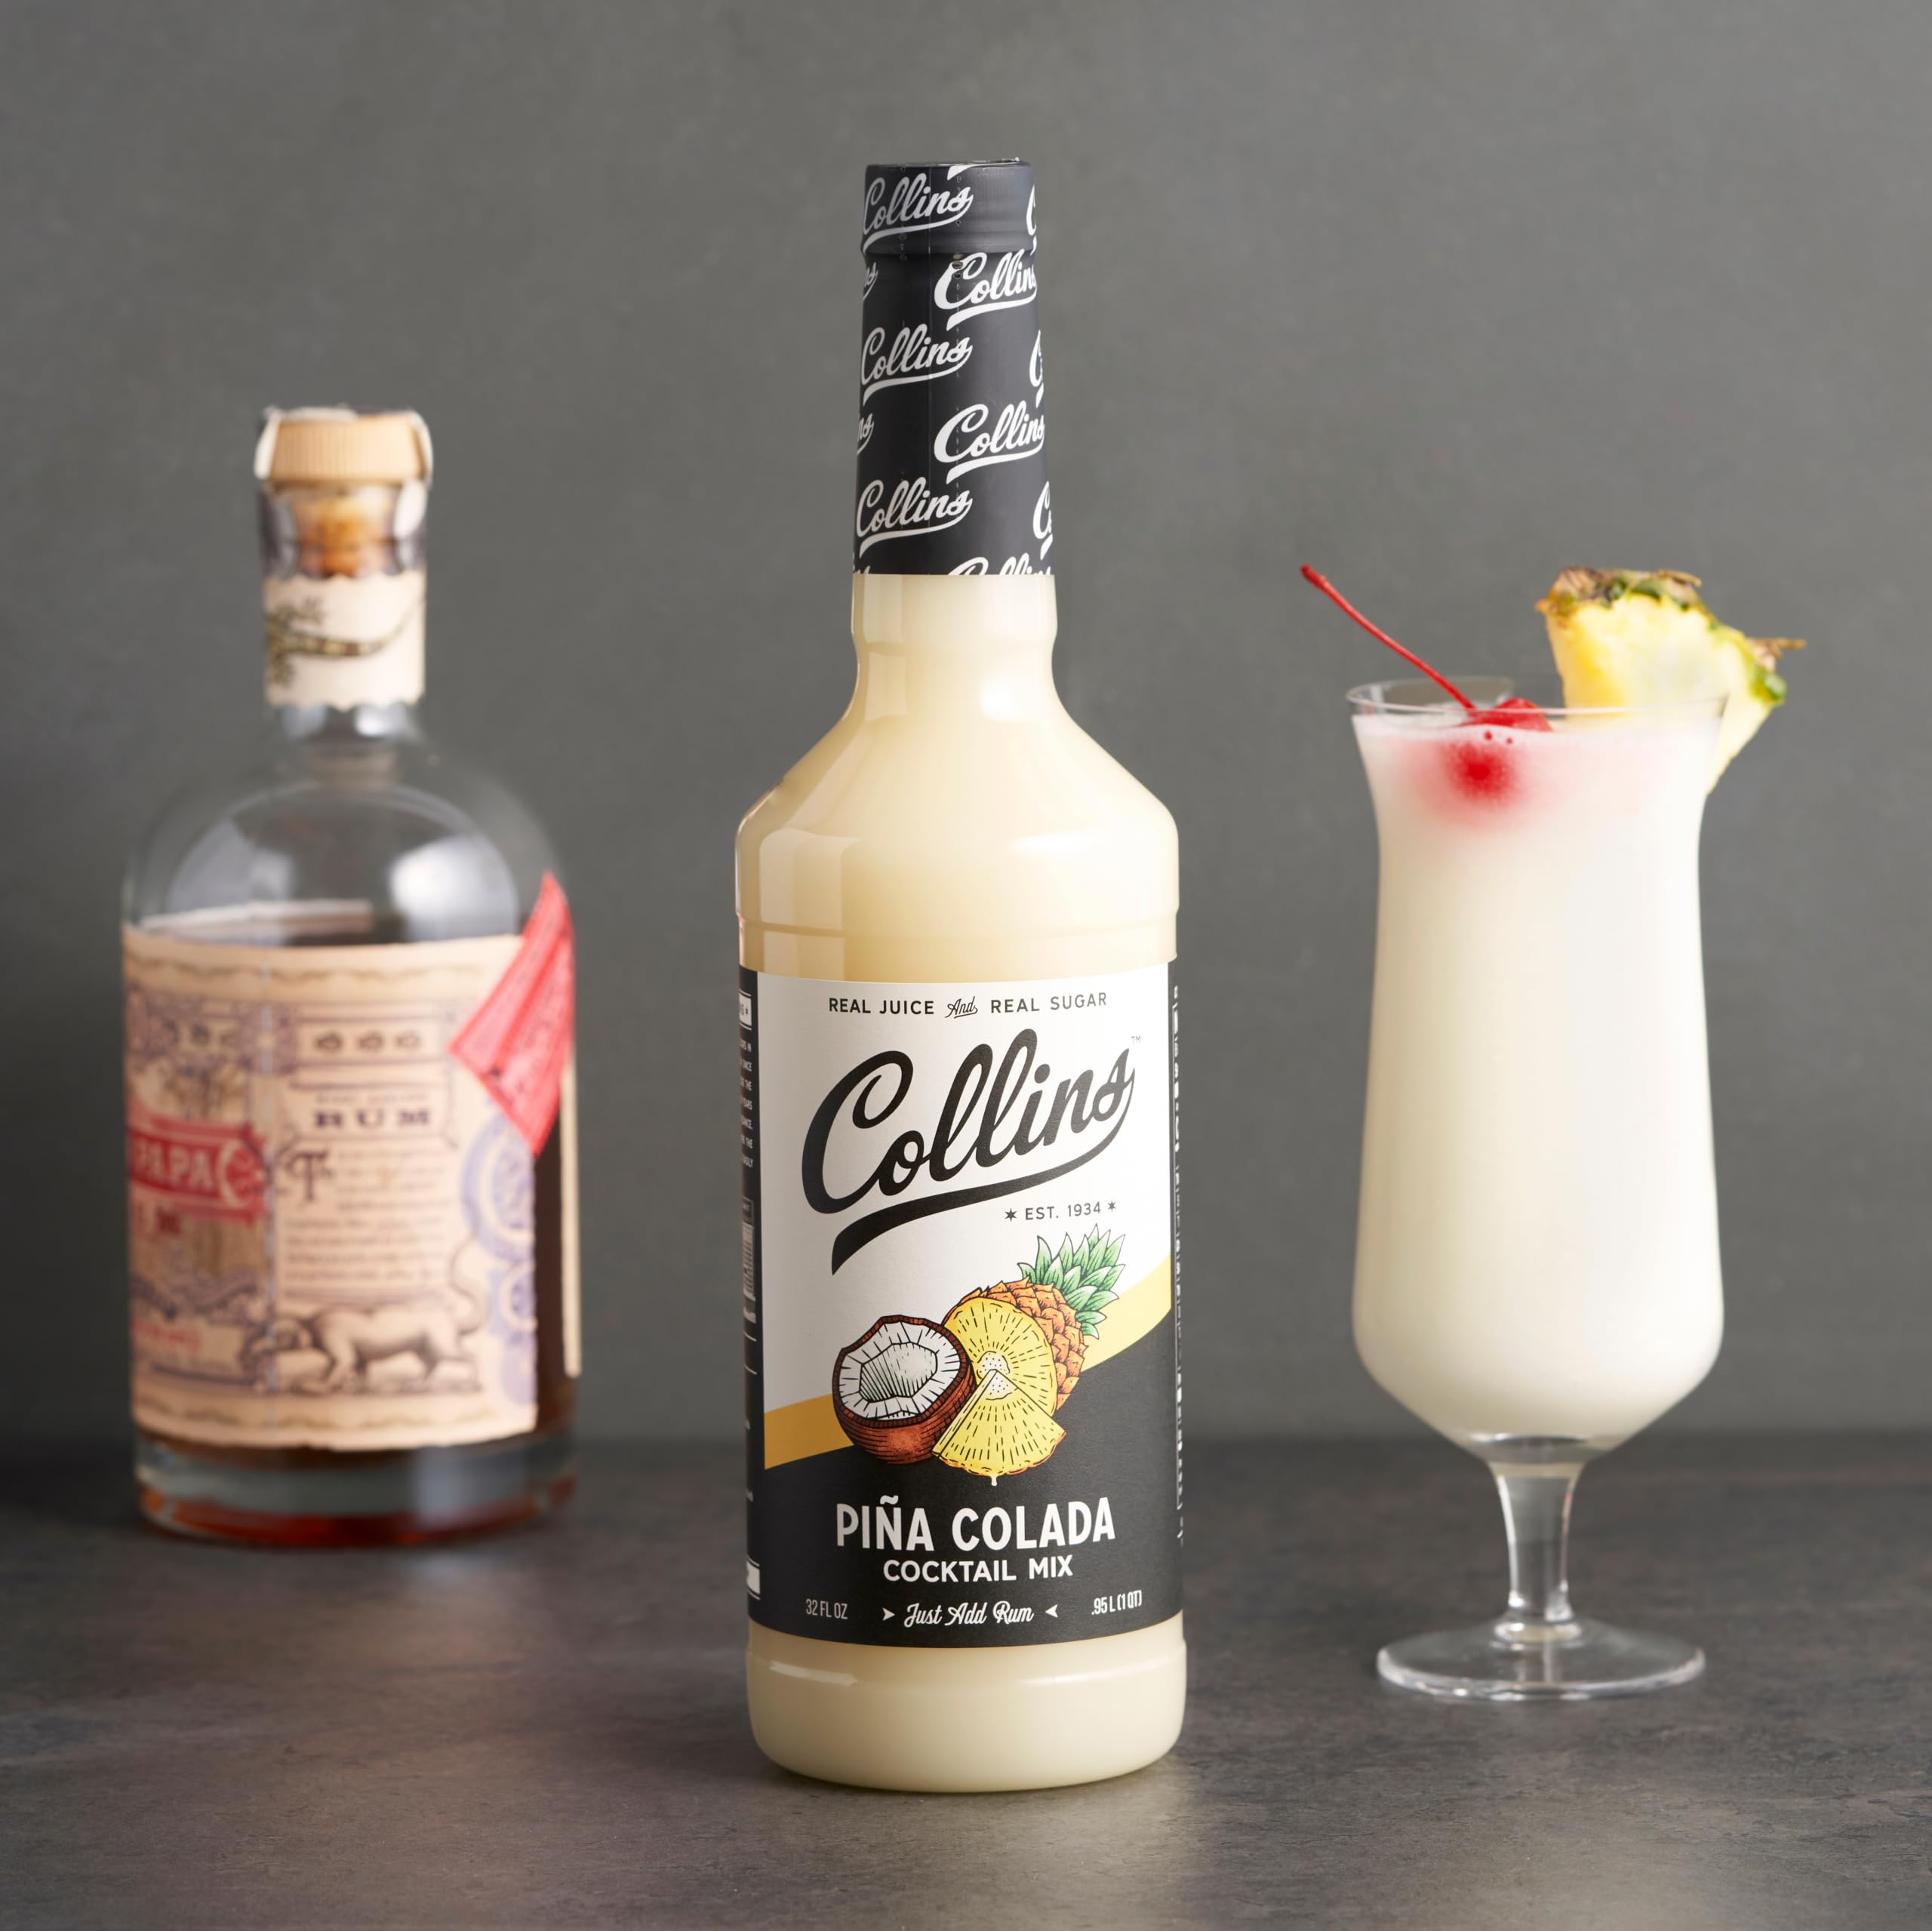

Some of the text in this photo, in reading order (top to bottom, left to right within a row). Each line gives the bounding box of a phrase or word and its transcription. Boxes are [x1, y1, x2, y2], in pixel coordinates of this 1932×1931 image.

[863, 173, 974, 252] Collins
[861, 323, 973, 406] Collins
[857, 476, 973, 558] Collins
[829, 992, 1107, 1019] REAL JUICE And REAL SUGAR
[315, 1111, 429, 1127] RUM
[802, 1029, 1135, 1275] Collins
[1025, 1201, 1101, 1220] EST. 1934
[836, 1495, 1116, 1551] PIÑA COLADA
[883, 1554, 1074, 1584] COCKTAIL MIX
[805, 1598, 819, 1616] 32
[820, 1600, 832, 1618] FL
[834, 1602, 848, 1620] OZ
[904, 1602, 943, 1628] Just
[944, 1602, 988, 1626] Add
[992, 1600, 1035, 1625] Rum
[1091, 1596, 1108, 1616] .95
[1109, 1595, 1116, 1613] L
